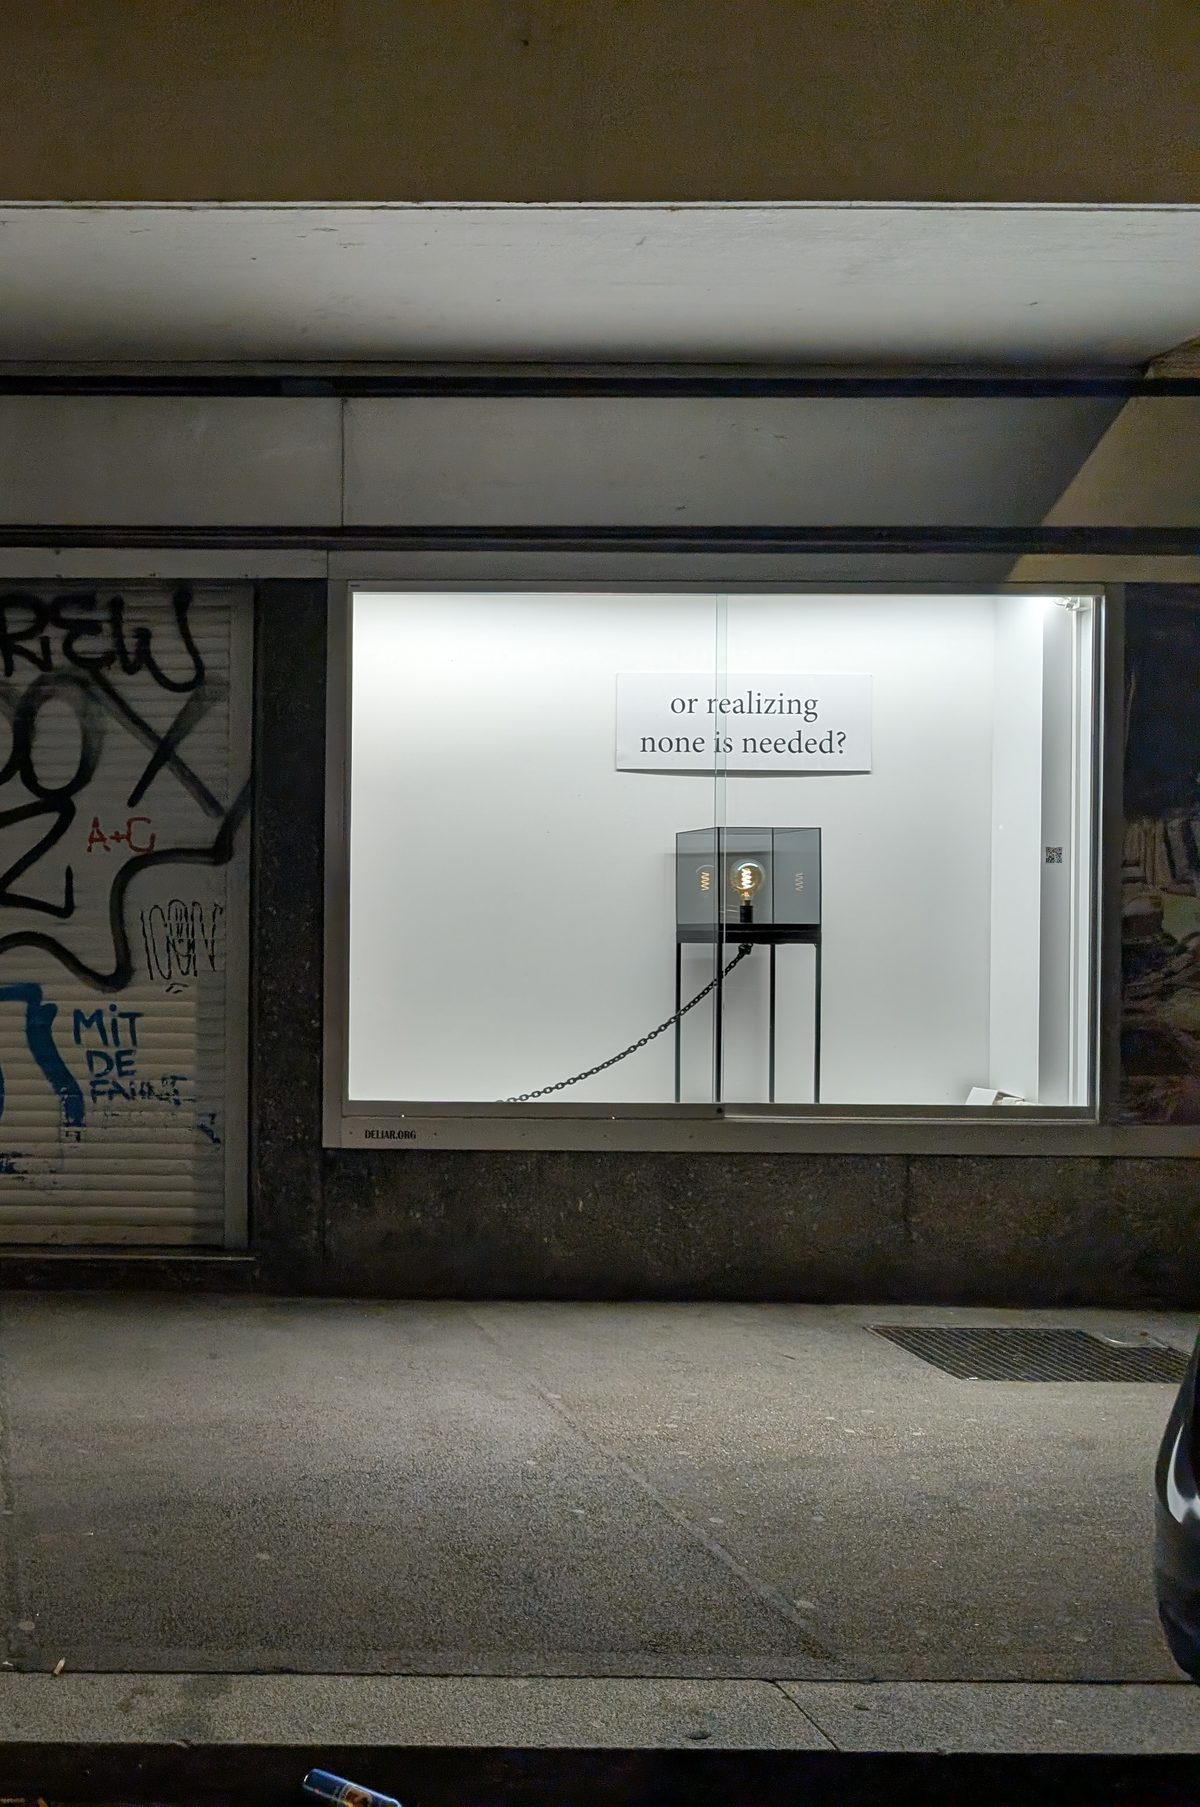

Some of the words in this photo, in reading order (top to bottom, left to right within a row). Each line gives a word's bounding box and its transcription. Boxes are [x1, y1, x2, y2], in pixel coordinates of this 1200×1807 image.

[670, 697, 699, 714] or
[706, 690, 819, 723] realizing
[640, 736, 706, 753] none
[714, 731, 733, 753] is
[742, 730, 846, 754] needed?
[86, 1050, 138, 1076] DE
